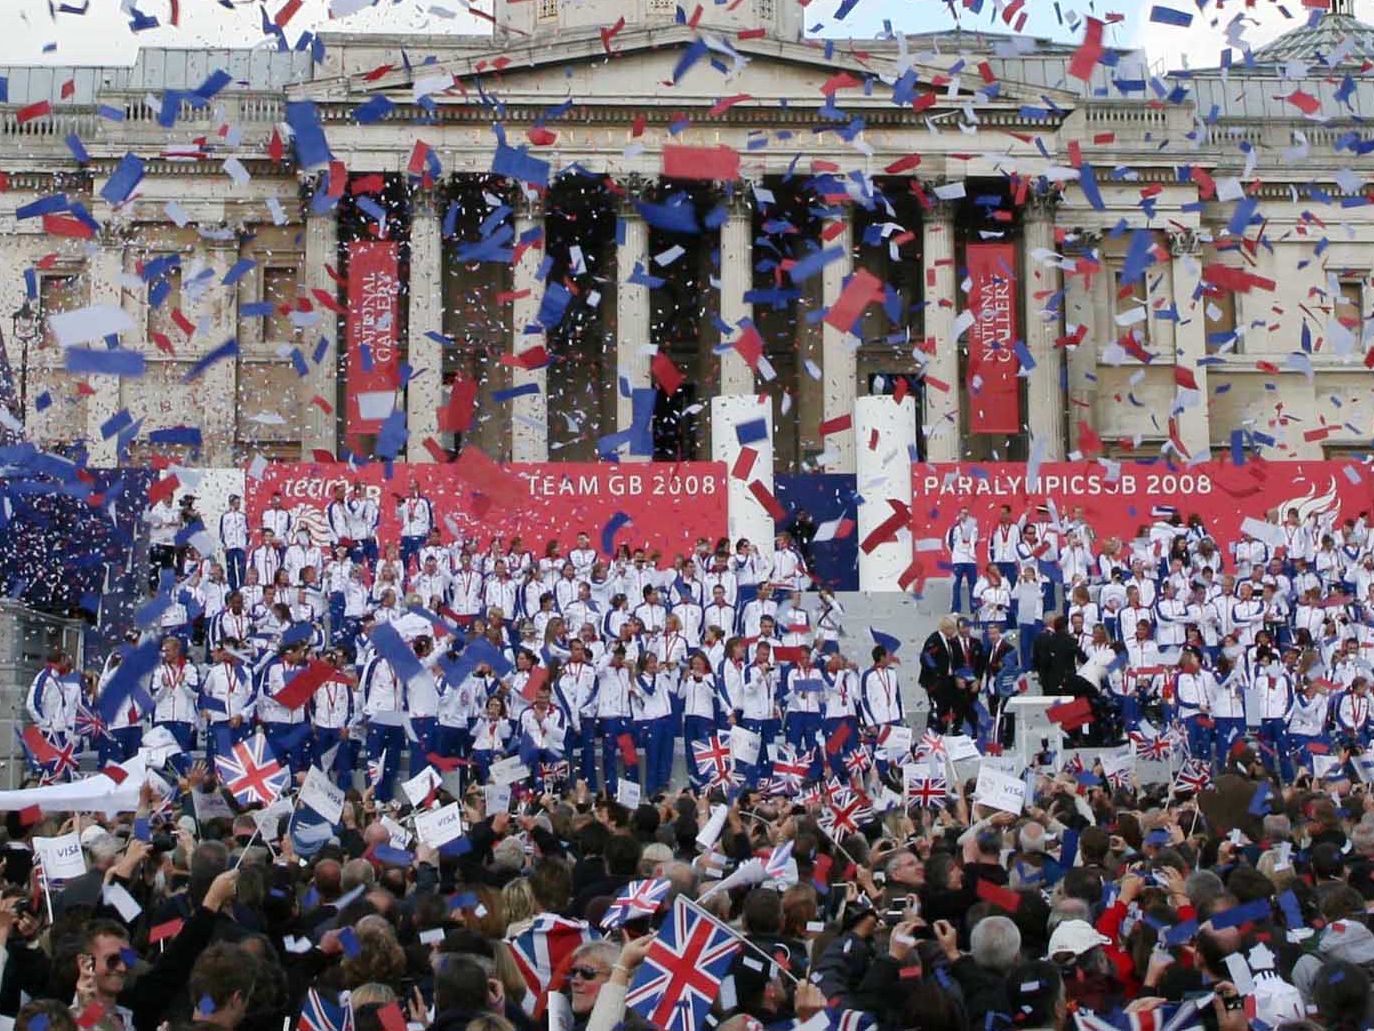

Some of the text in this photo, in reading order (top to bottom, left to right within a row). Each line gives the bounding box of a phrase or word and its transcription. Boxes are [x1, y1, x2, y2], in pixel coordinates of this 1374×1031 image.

[528, 475, 715, 495] TEAM GB 2008
[1146, 475, 1212, 494] 2008
[1002, 784, 1024, 798] VISA
[438, 813, 457, 827] VISA
[56, 844, 79, 858] VISA
